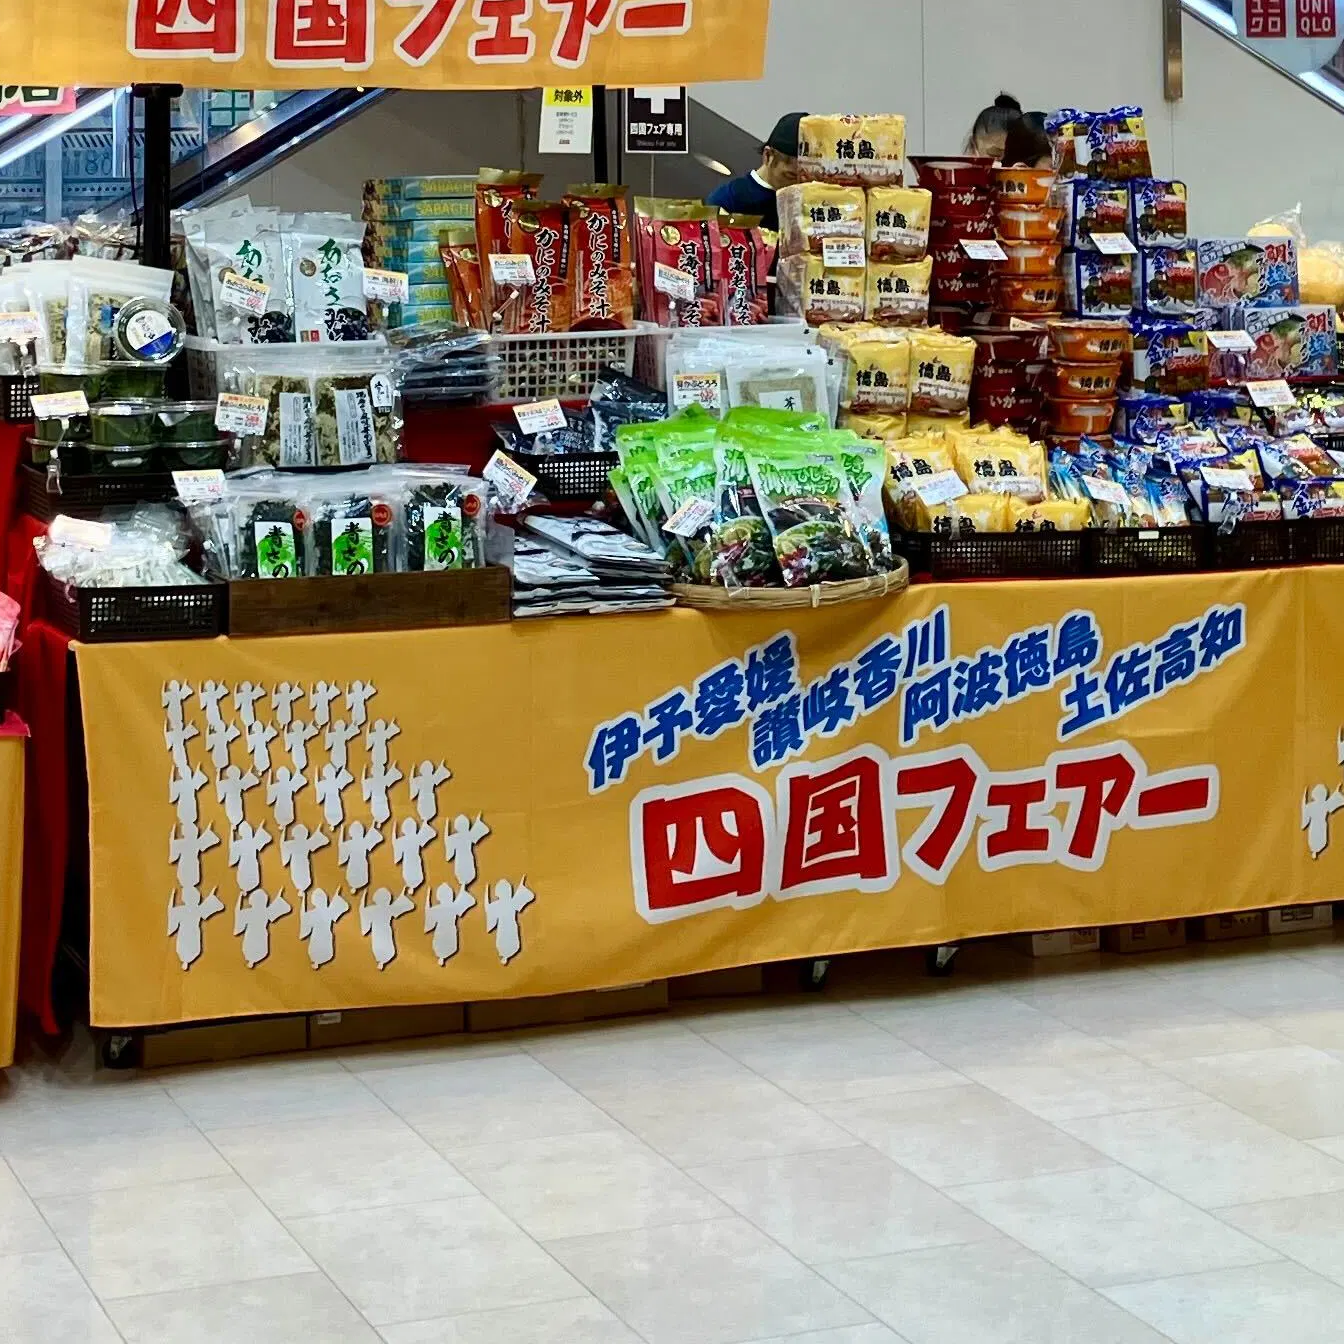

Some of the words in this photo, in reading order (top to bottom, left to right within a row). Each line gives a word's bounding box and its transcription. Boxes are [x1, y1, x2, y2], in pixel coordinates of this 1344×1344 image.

[1250, 16, 1281, 33] クロ
[1301, 17, 1332, 35] QLO
[553, 89, 584, 103] 対象外
[629, 122, 683, 136] 四国フェア専用
[836, 139, 876, 160] 徳島
[810, 207, 842, 223] 徳島
[875, 210, 908, 229] 徳島
[587, 213, 612, 319] かにのみそ汁
[529, 230, 559, 334] かにのみそ汁
[728, 246, 752, 326] 甘海老のみそ
[809, 278, 841, 297] 徳島
[877, 277, 910, 294] 徳島
[856, 369, 890, 389] 徳島
[919, 361, 952, 383] 徳島
[891, 458, 933, 481] 徳島
[974, 459, 1018, 478] 徳島
[903, 615, 1101, 742] 阿波徳島
[1059, 606, 1244, 738] 土佐高知
[753, 610, 947, 767] 讃岐香川
[588, 634, 798, 790] 伊予愛媛
[642, 753, 1211, 911] 四国フェアー
